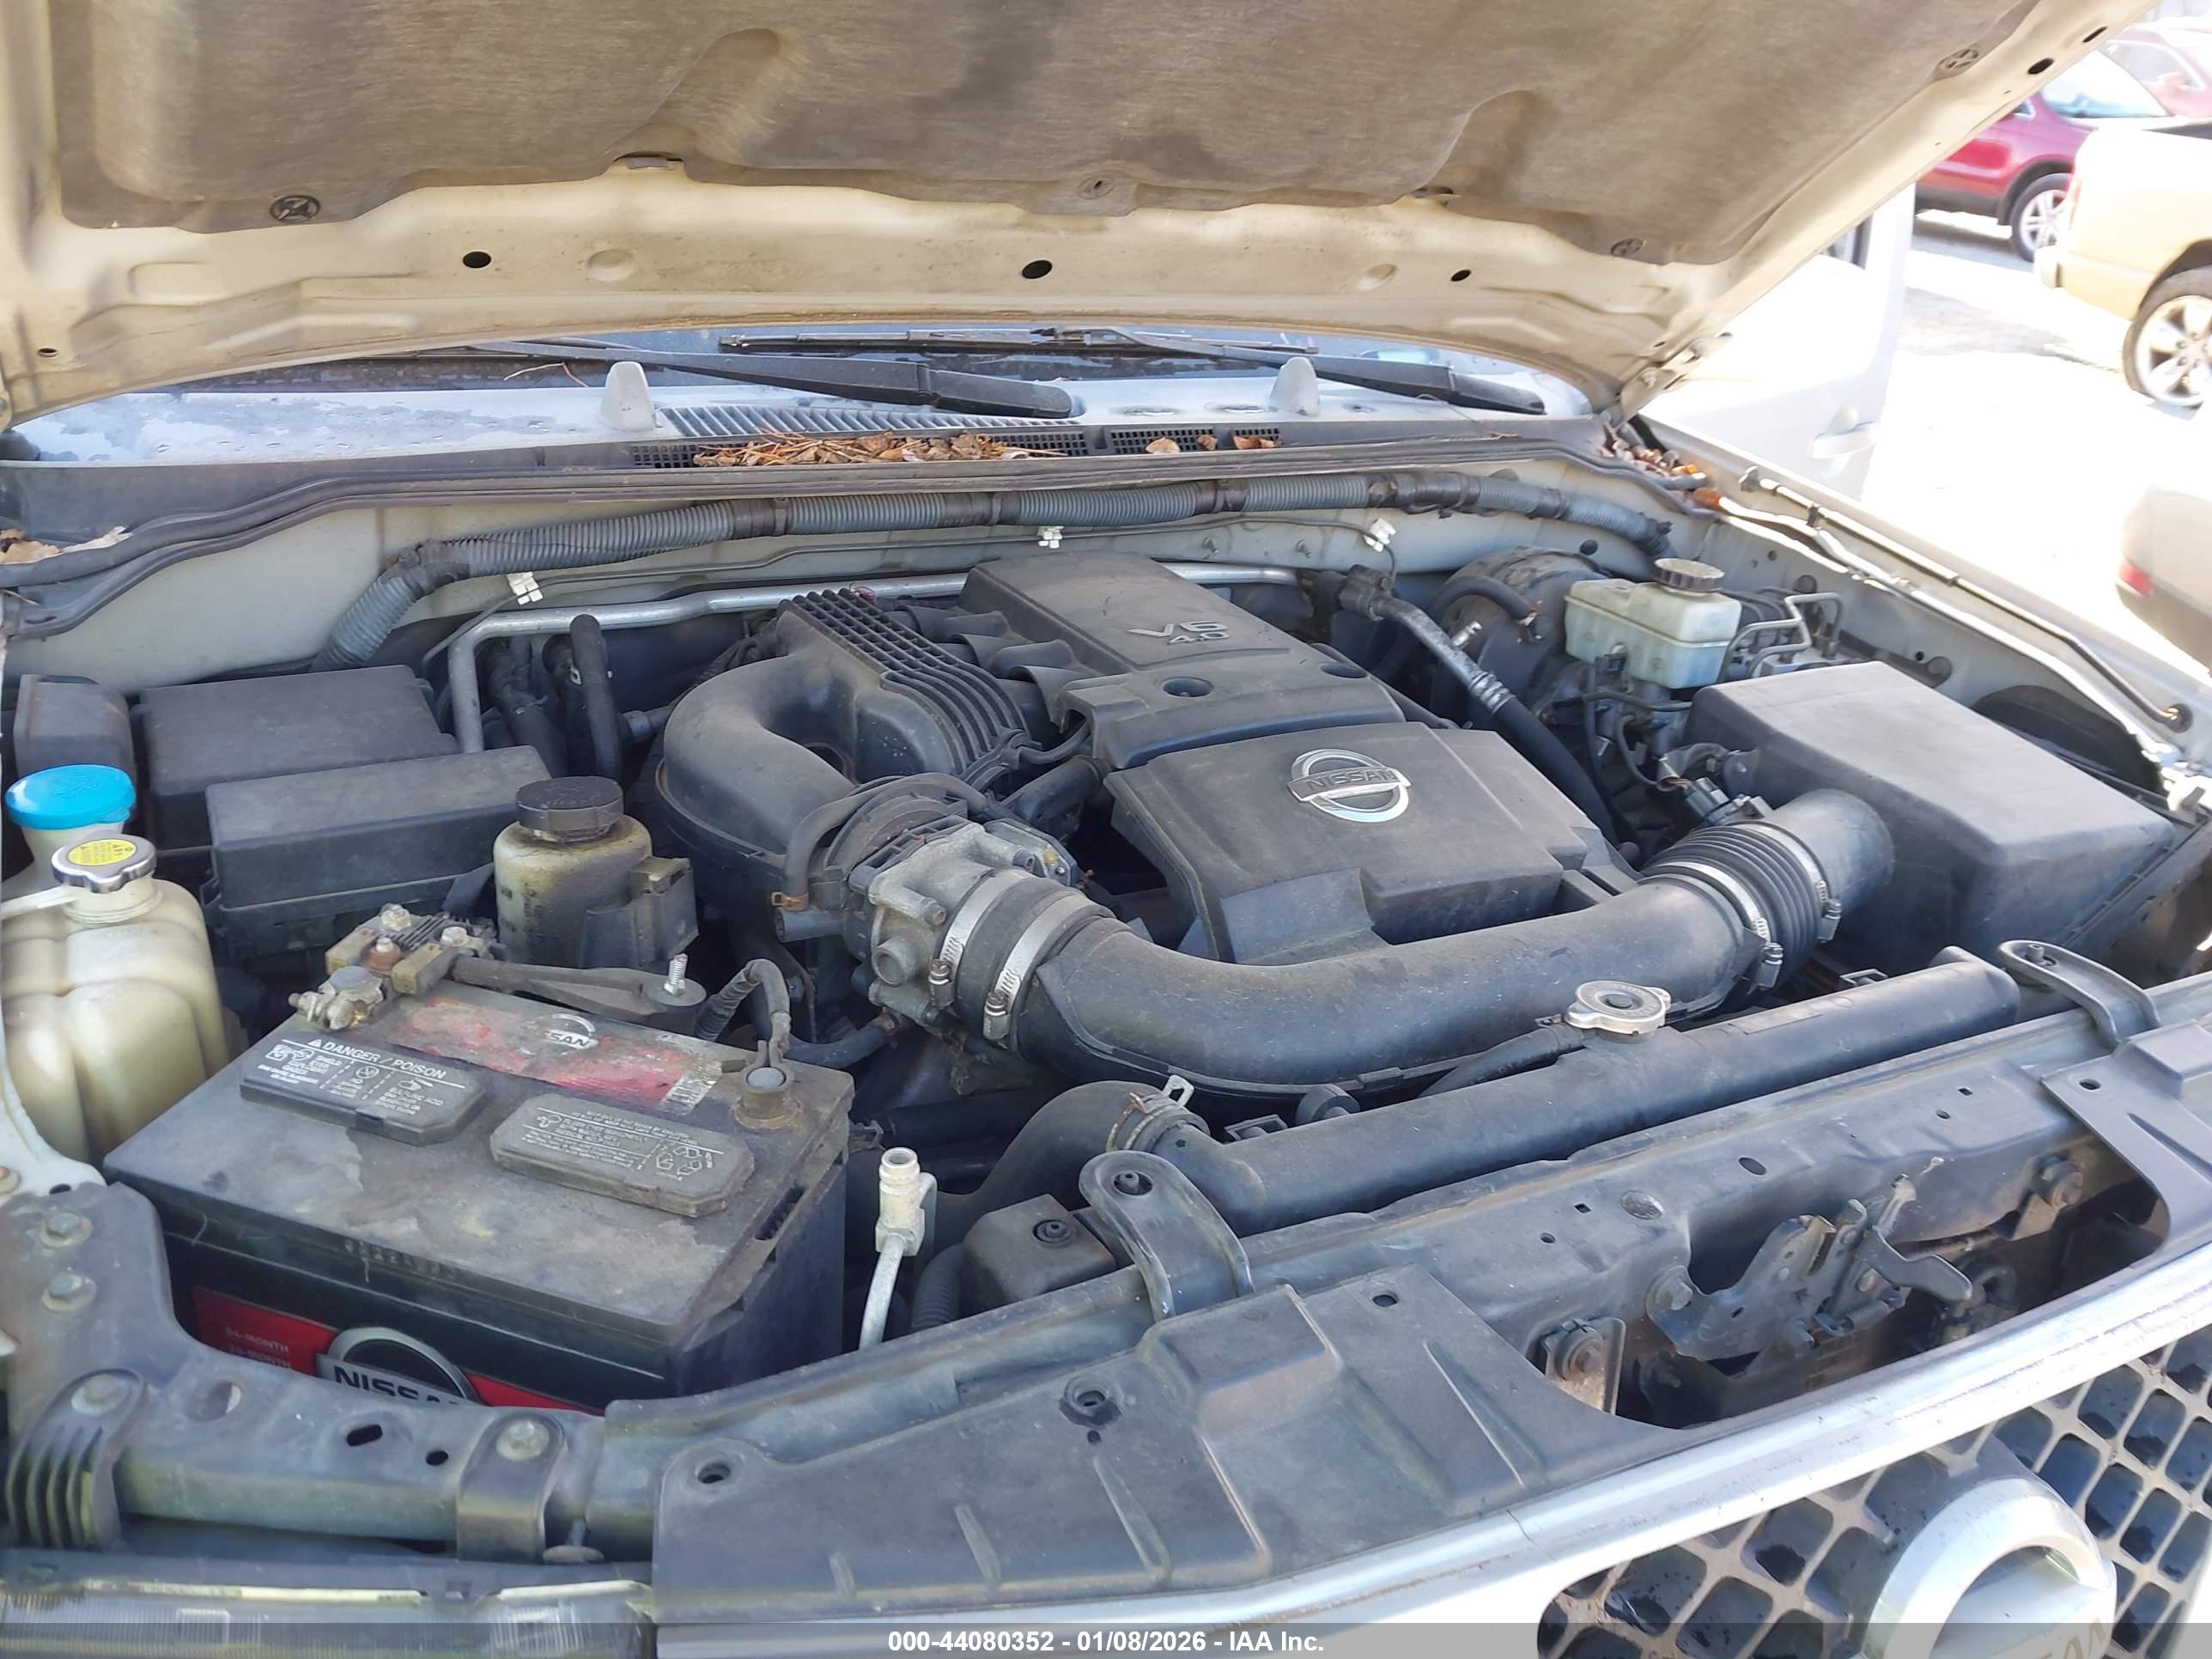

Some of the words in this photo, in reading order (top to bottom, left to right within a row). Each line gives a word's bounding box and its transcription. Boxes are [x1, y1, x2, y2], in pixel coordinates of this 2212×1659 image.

[1127, 620, 1229, 639] V6
[1167, 631, 1230, 646] 4.0
[1305, 768, 1398, 791] NISSAN
[323, 1041, 380, 1062] DANGER
[393, 1059, 447, 1079] POISON
[334, 1365, 459, 1405] NISS
